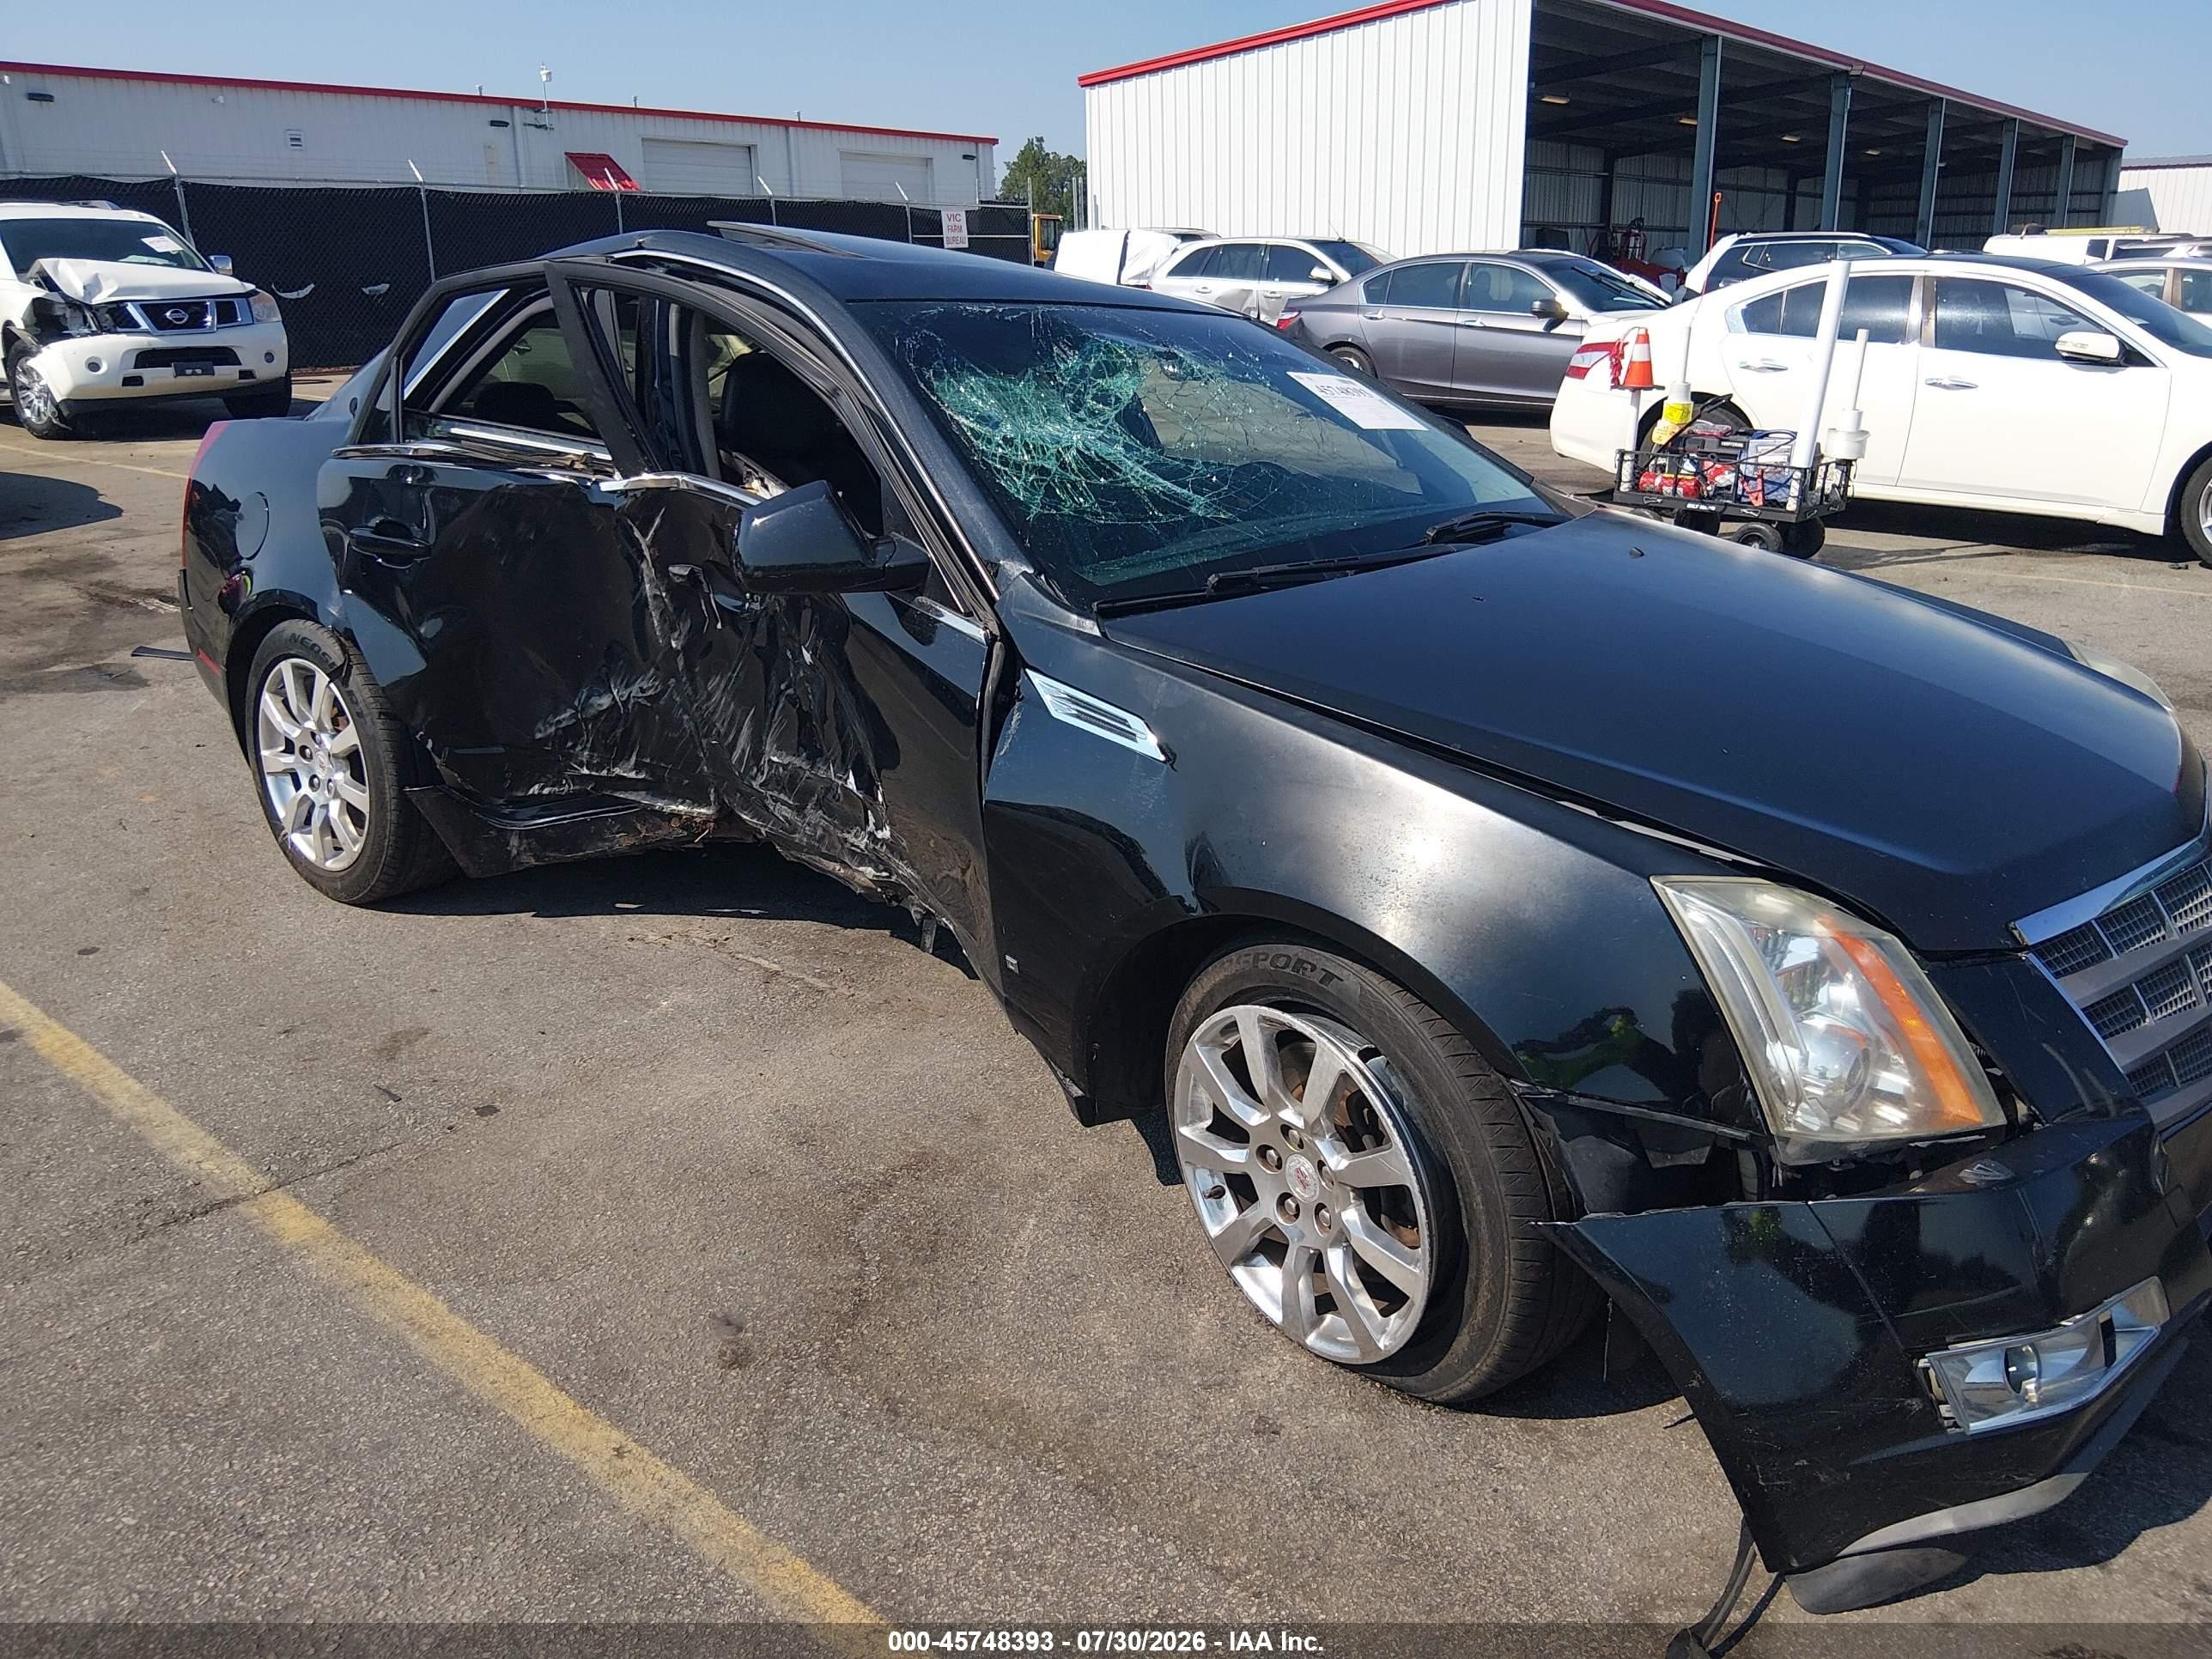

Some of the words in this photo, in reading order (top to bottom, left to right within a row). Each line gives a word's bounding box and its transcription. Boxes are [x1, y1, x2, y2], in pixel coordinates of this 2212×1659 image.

[946, 213, 962, 222] VIC
[947, 224, 963, 234] FARM
[945, 236, 967, 245] BUREAU
